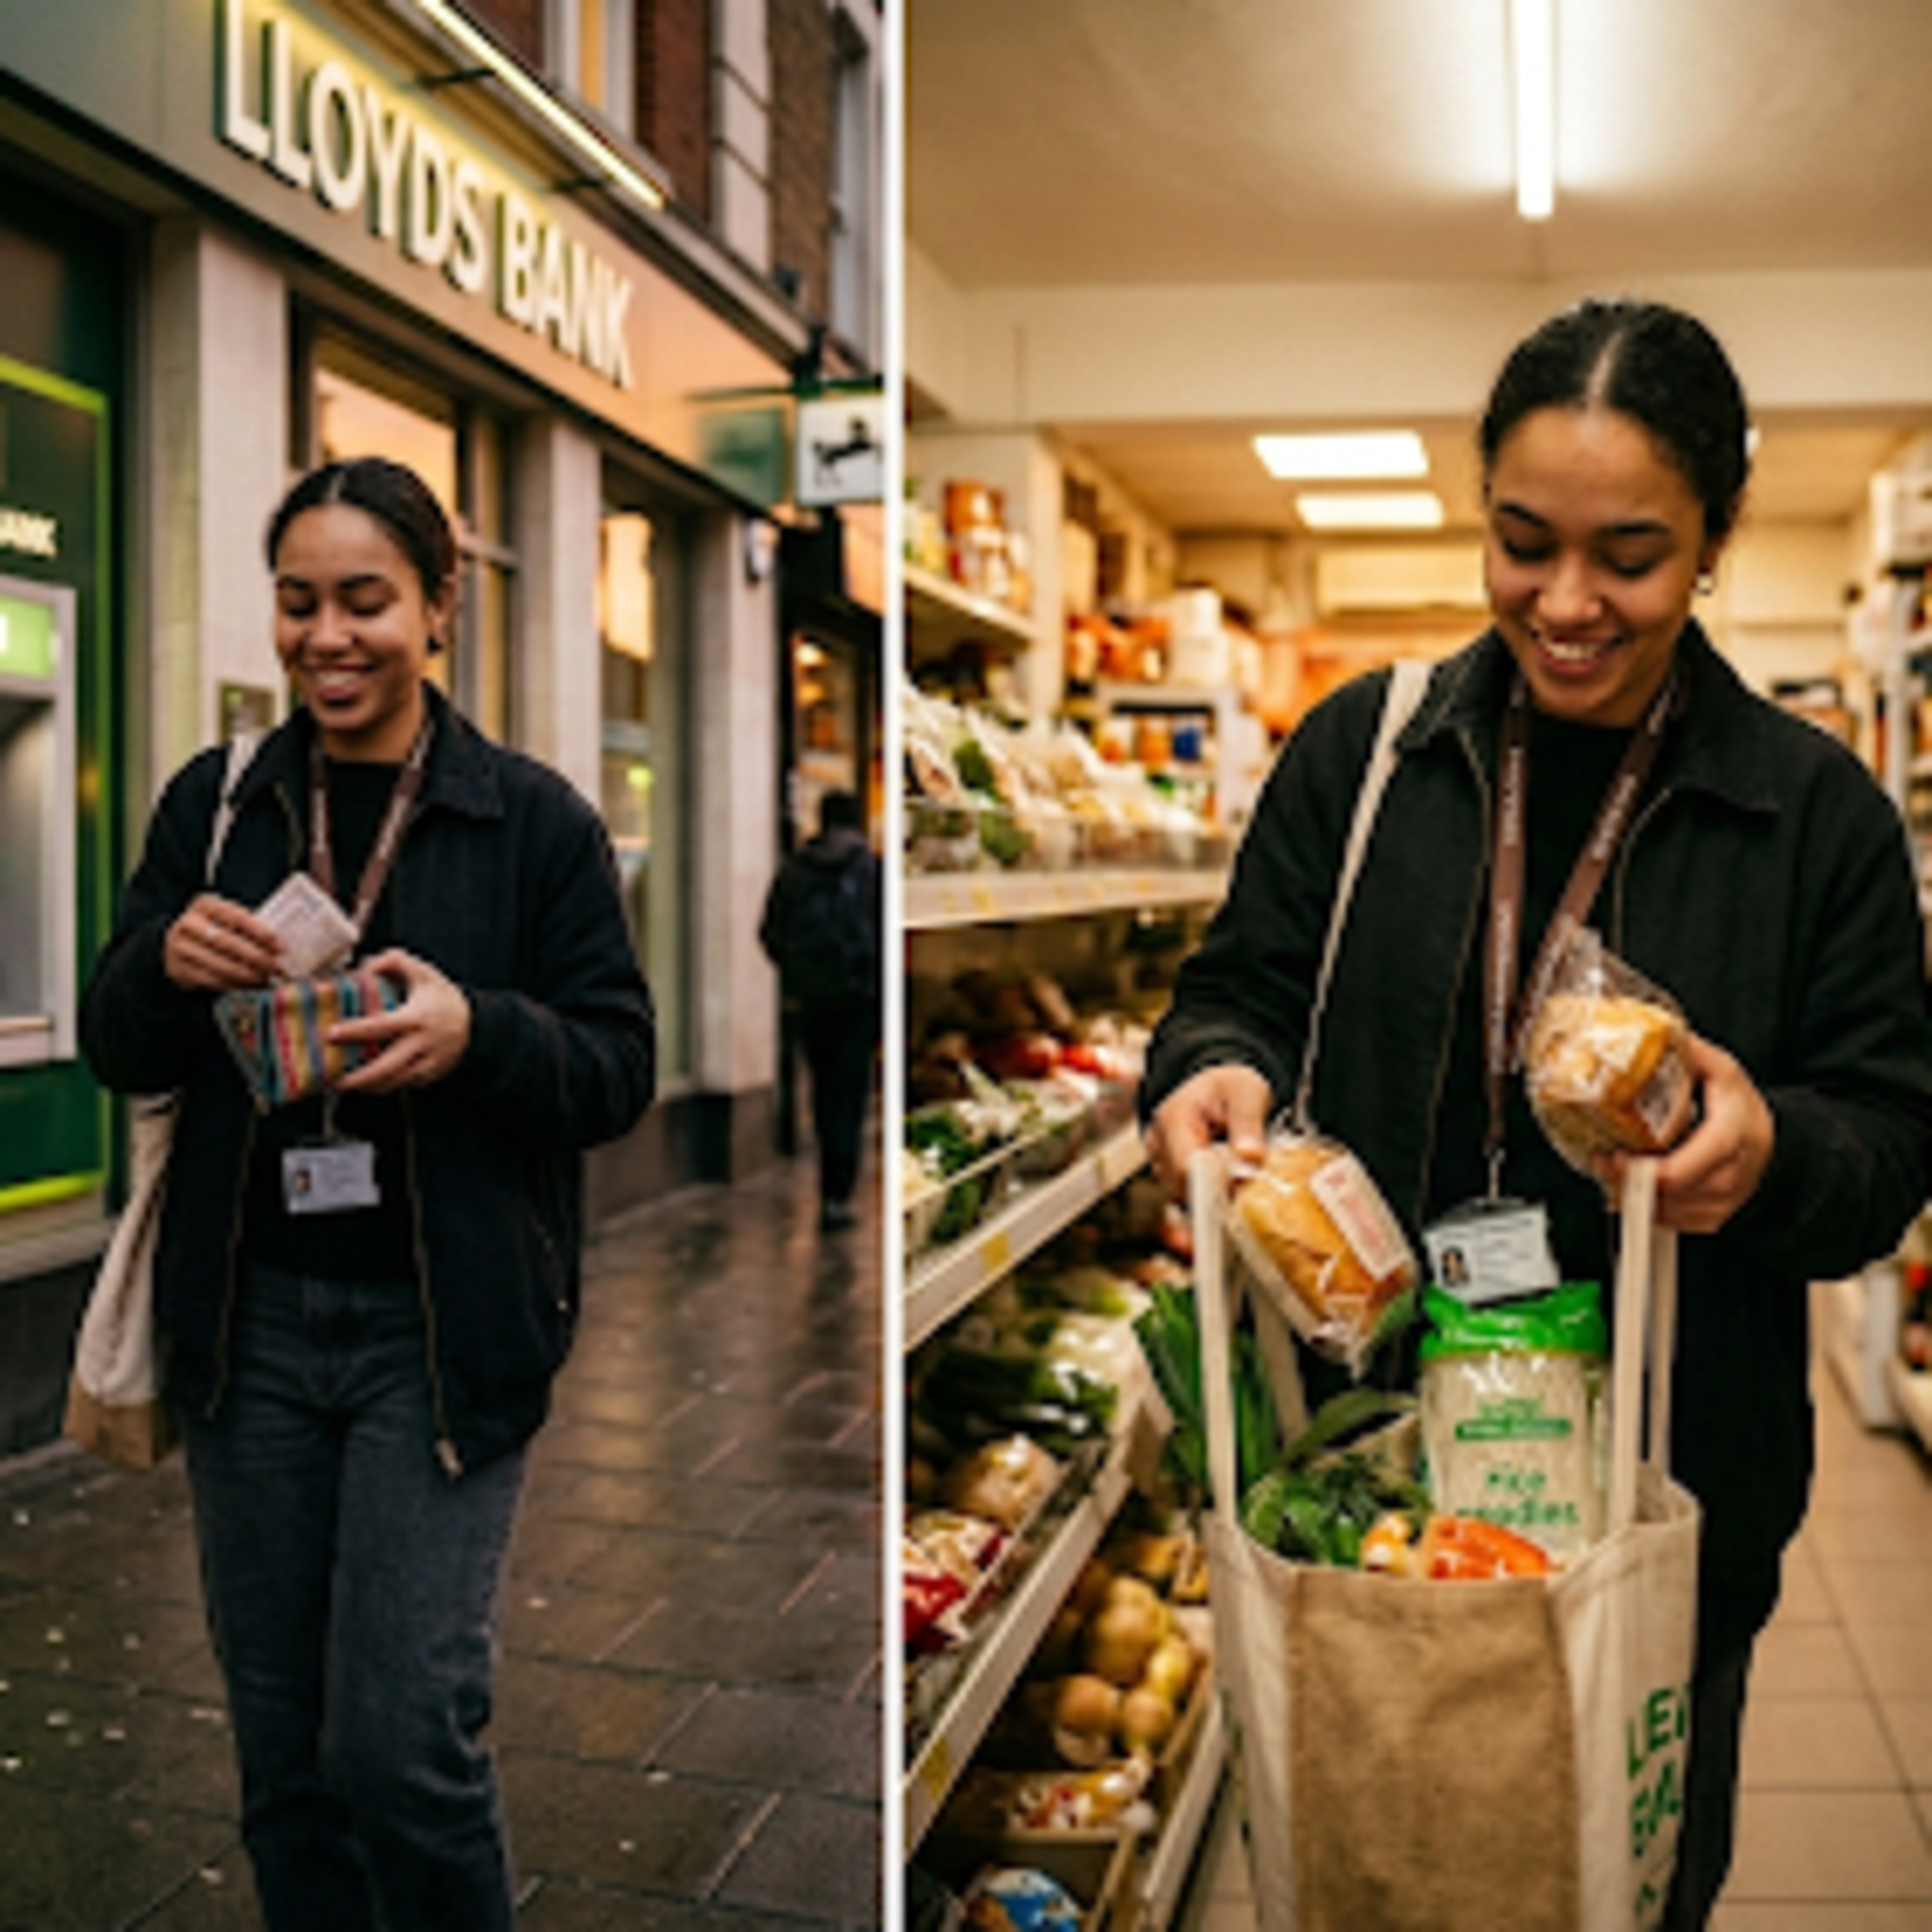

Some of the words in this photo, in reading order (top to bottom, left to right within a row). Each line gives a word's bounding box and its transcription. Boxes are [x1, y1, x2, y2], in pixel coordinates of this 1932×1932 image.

[218, 0, 488, 294] LLOYDS
[495, 191, 635, 390] BANK
[0, 507, 57, 560] ANK
